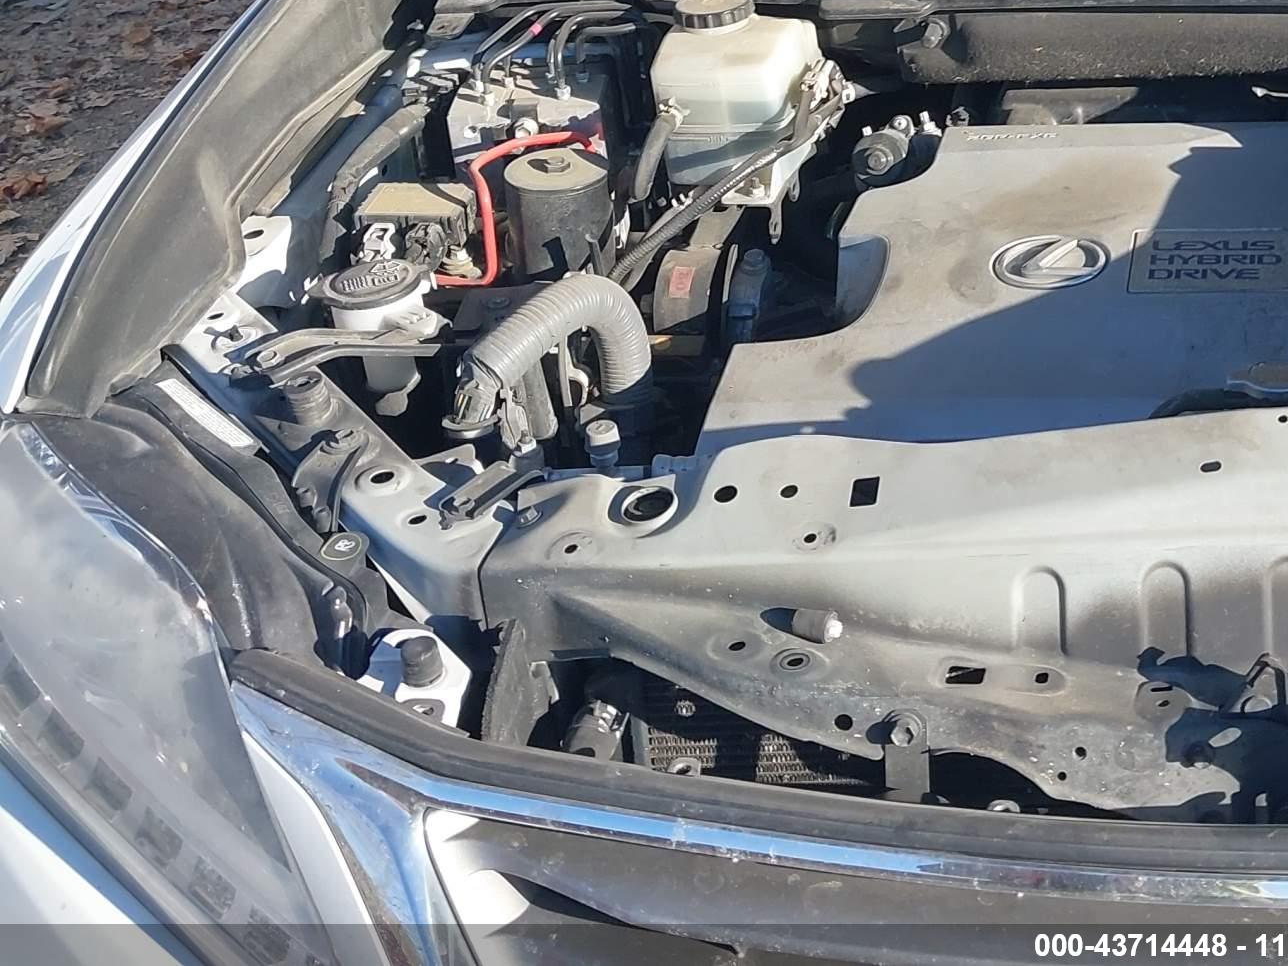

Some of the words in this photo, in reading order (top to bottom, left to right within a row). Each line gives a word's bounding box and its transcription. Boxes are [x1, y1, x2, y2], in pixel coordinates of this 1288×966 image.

[1152, 240, 1276, 251] LEXUS
[1150, 254, 1282, 265] HYBRID
[1148, 268, 1261, 280] DRIVE
